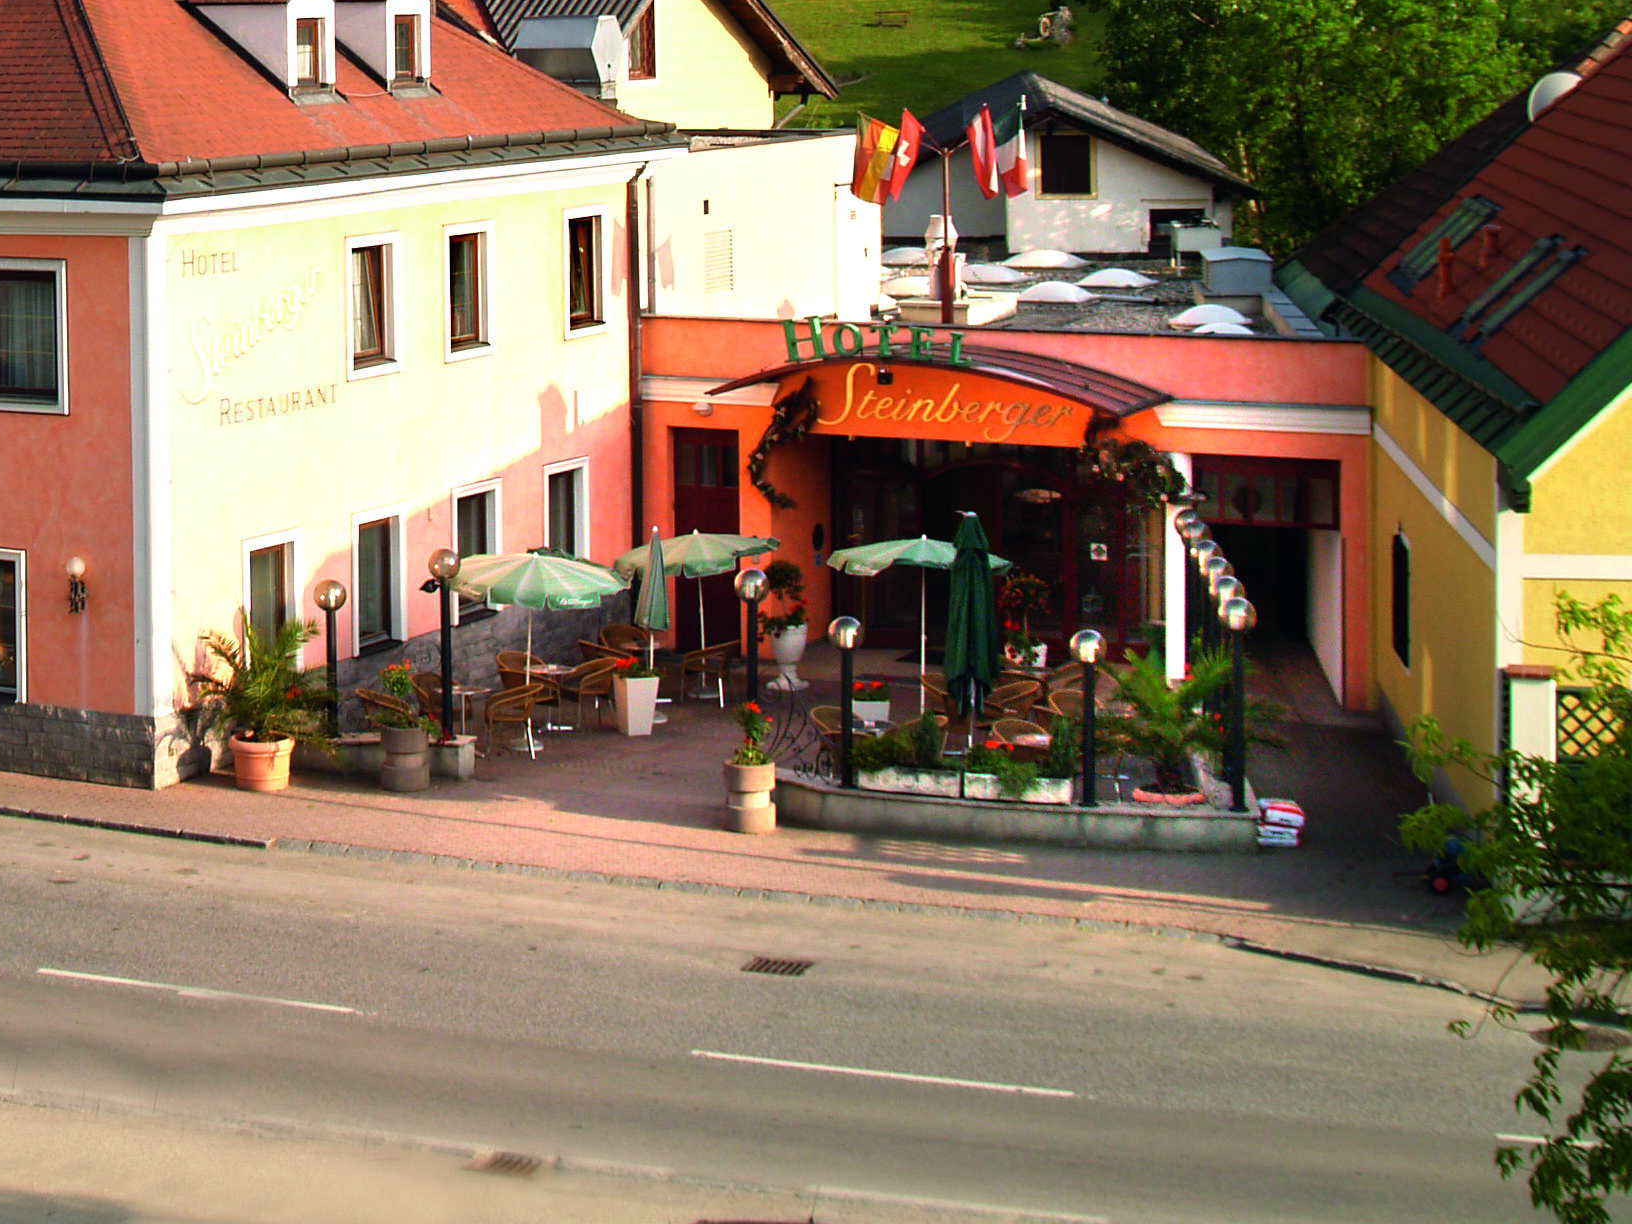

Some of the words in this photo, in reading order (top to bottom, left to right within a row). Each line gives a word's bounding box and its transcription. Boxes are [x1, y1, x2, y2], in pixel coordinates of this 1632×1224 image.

[181, 248, 239, 277] HOTEL
[780, 316, 973, 367] HOTEL
[220, 383, 338, 427] RESTAURANT
[817, 362, 1073, 442] Steinberger
